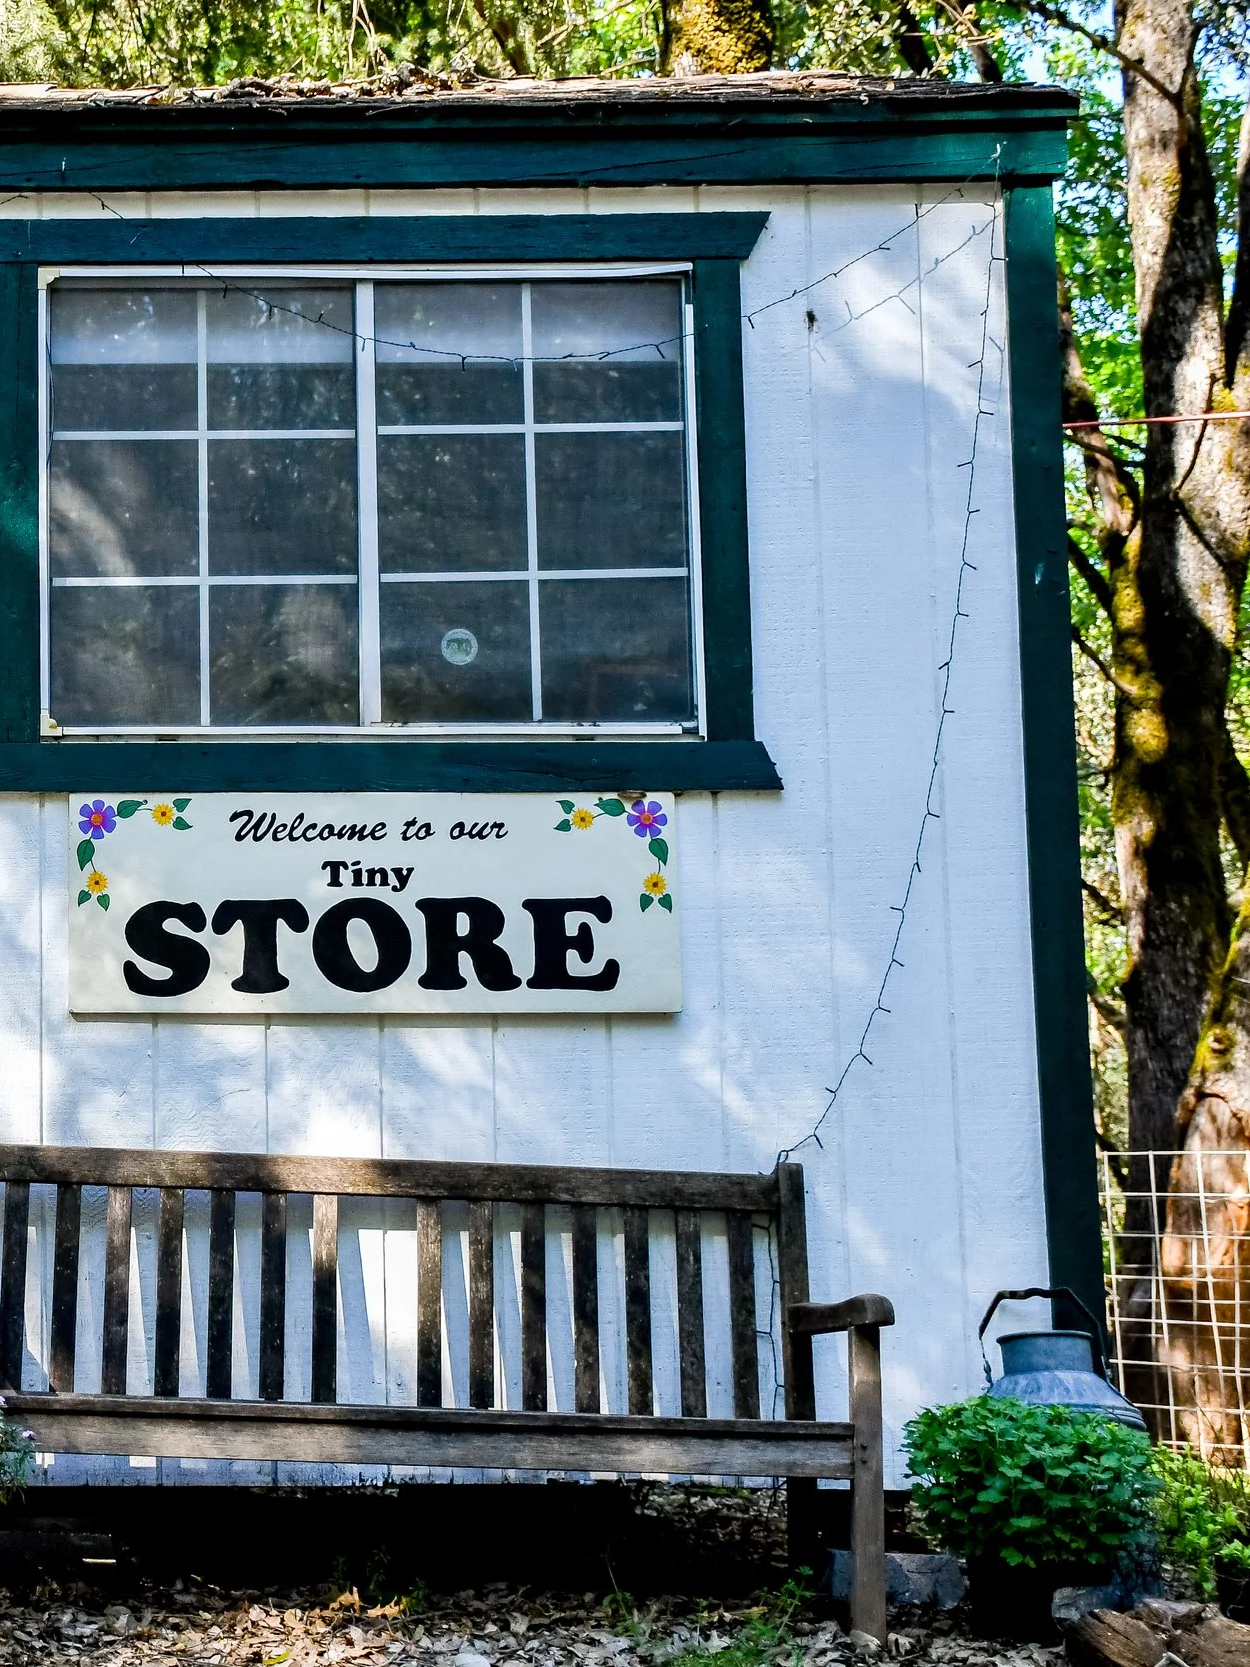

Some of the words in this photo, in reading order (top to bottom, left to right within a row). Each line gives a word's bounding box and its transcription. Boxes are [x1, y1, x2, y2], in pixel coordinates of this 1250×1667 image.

[229, 809, 389, 843] Welcome
[402, 815, 436, 841] to
[449, 819, 509, 841] our
[320, 860, 416, 893] Tiny
[122, 896, 621, 998] STORE
